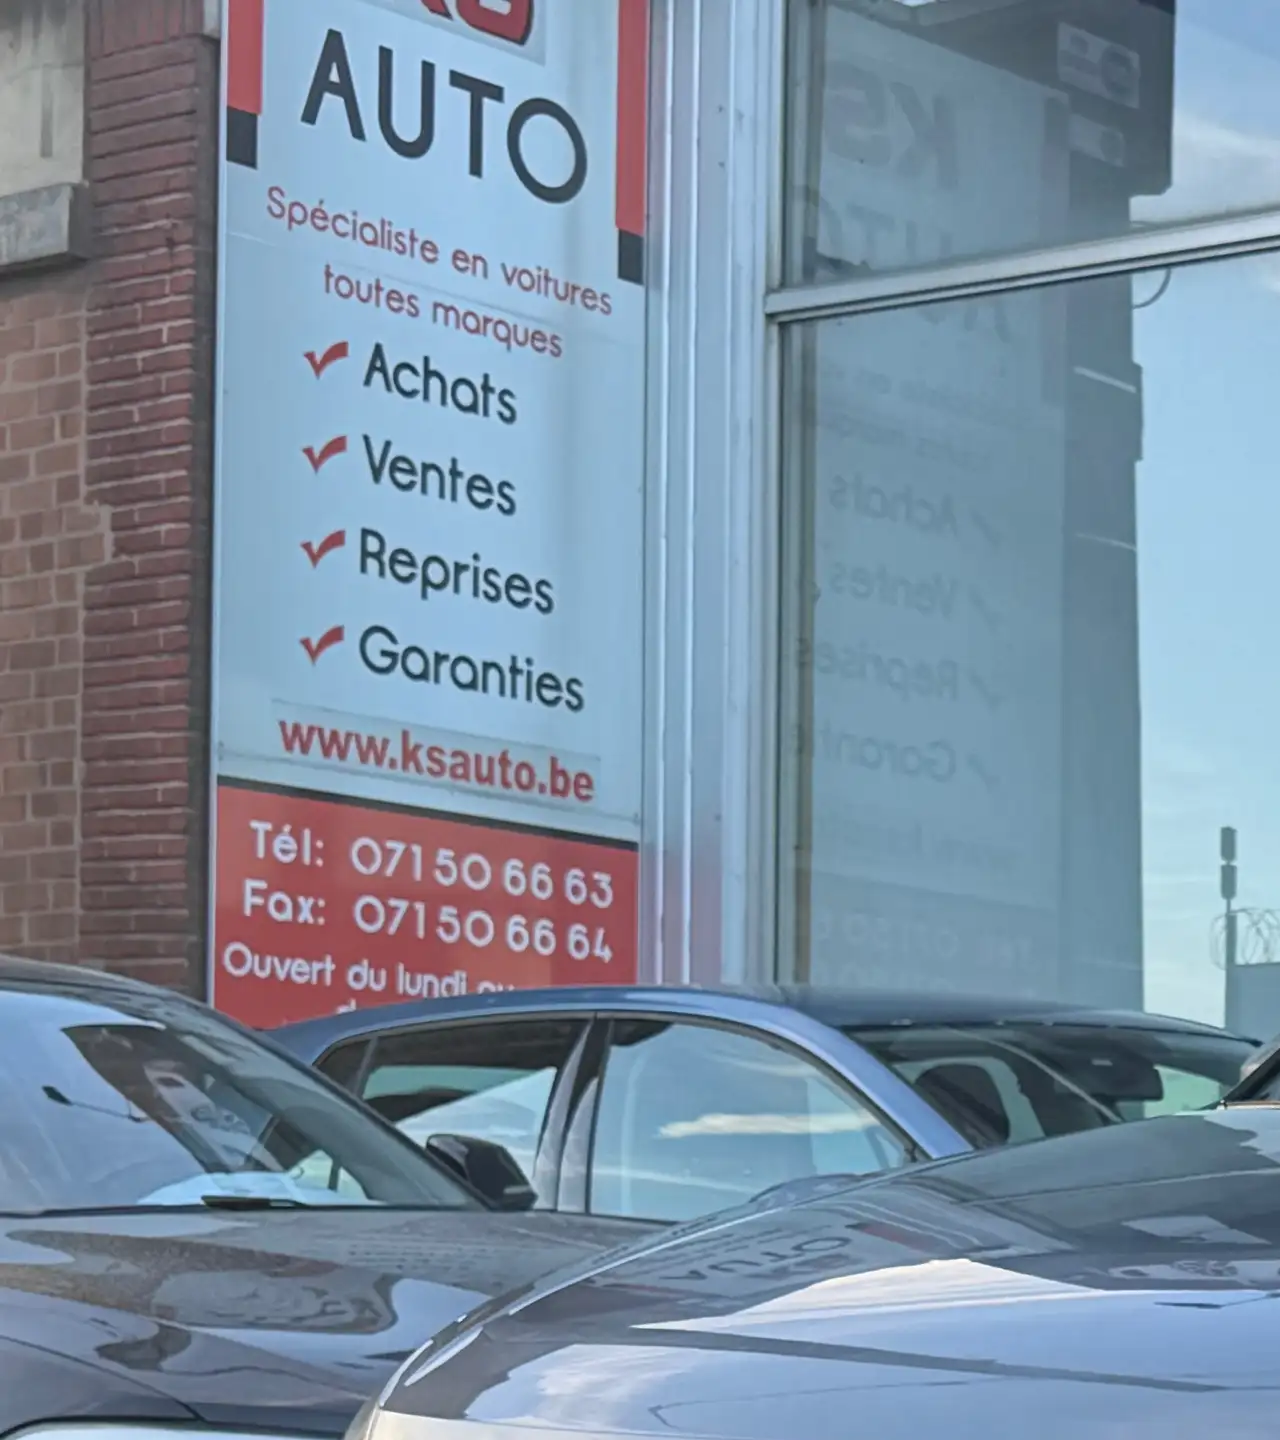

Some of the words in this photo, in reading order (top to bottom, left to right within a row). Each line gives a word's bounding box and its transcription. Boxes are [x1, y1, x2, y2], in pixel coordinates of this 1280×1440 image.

[301, 28, 588, 204] AUTO
[266, 185, 440, 263] Spécialiste
[450, 247, 488, 281] en
[501, 261, 613, 315] voitures
[323, 264, 420, 318] toutes
[432, 301, 563, 358] marques
[363, 342, 518, 425] Achats
[362, 433, 517, 516] Ventes
[360, 528, 555, 614] Reprises
[358, 624, 585, 713] Garanties
[278, 718, 595, 802] www.ksauto.be
[249, 820, 324, 867] Tél:
[504, 858, 554, 900] 66
[563, 867, 614, 909] 63
[242, 880, 325, 926] Fax:
[505, 915, 556, 956] 66
[567, 924, 613, 964] 64
[222, 942, 335, 986] Ouvert
[346, 958, 387, 992] du
[396, 962, 467, 998] lundi
